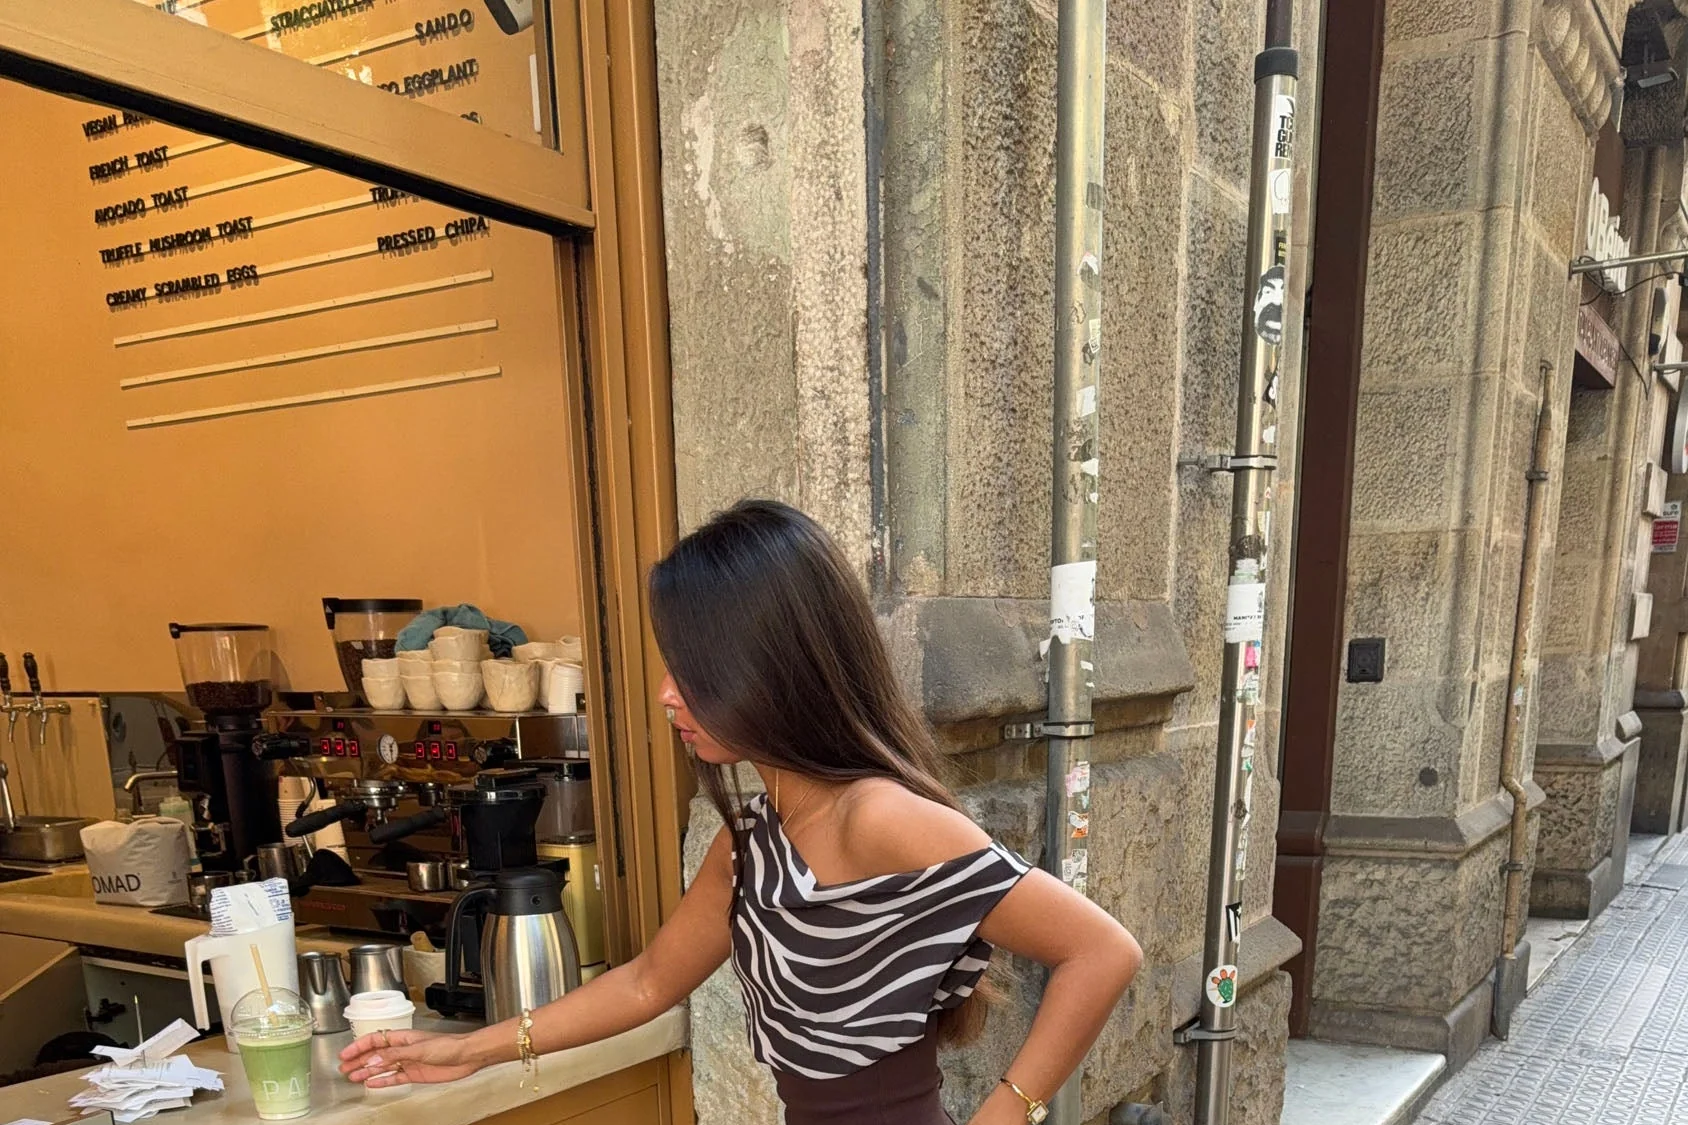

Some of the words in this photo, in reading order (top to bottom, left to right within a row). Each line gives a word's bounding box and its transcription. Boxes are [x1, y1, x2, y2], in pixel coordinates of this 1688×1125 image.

[415, 8, 472, 40] SANDO
[403, 58, 477, 94] EGGPLANT
[82, 113, 117, 137] VEGAN
[89, 155, 129, 181] FRENCH
[135, 145, 168, 168] TOAST
[95, 198, 146, 225] AVOCADO
[151, 186, 189, 208] TOAST
[99, 242, 143, 265] TRUFFLE
[149, 226, 212, 252] MUSHROOM
[216, 216, 254, 237] TOAST
[377, 226, 436, 252] PRESSED
[444, 215, 488, 240] CHIPA
[106, 287, 147, 307] CREAMY
[154, 273, 220, 297] SCRAMBLED
[226, 265, 258, 284] EGGS
